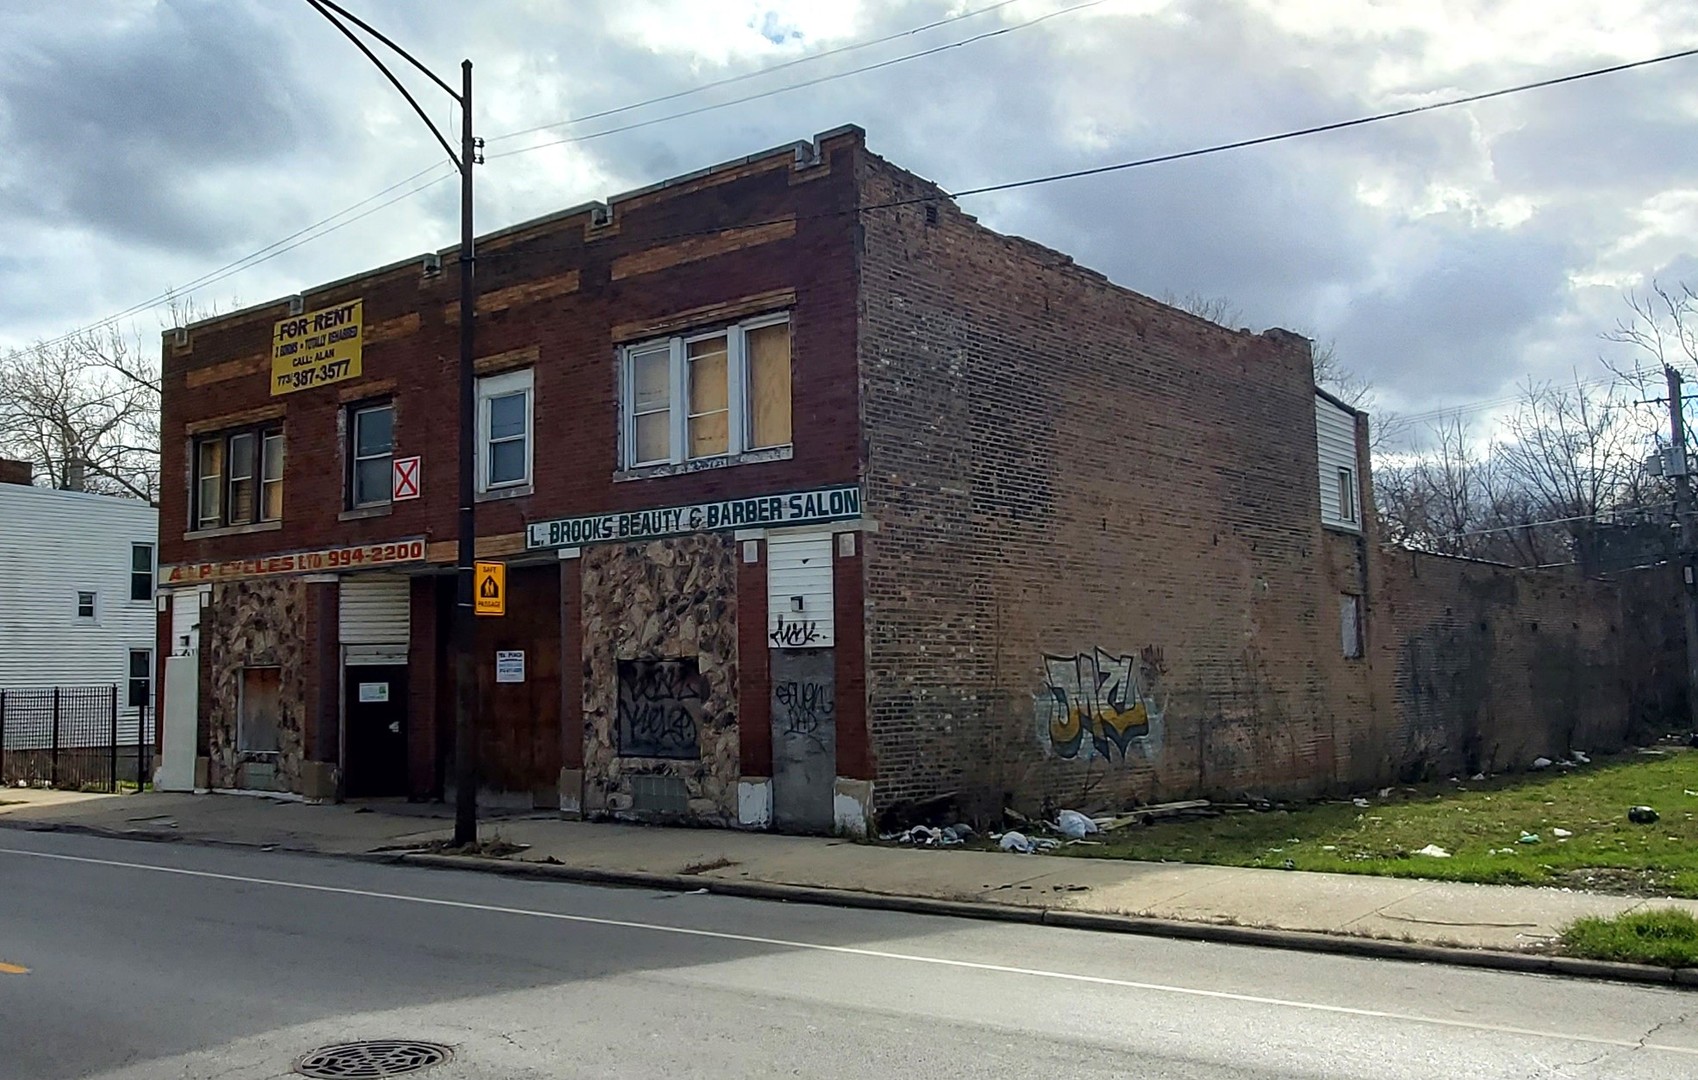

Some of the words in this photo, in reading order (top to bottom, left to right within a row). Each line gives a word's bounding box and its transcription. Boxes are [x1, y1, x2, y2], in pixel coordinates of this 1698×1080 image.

[280, 318, 308, 341] FOR
[313, 305, 355, 332] RENT
[292, 355, 313, 367] CALL:
[314, 348, 335, 362] ALAN
[550, 516, 613, 544] BROOKS
[619, 508, 682, 537] BEAUTY
[689, 507, 703, 529] &
[707, 497, 783, 528] BARBER
[789, 489, 859, 518] SALON
[328, 542, 422, 567] 994-2200
[483, 566, 497, 574] SAFE
[478, 600, 501, 608] PASSAGE
